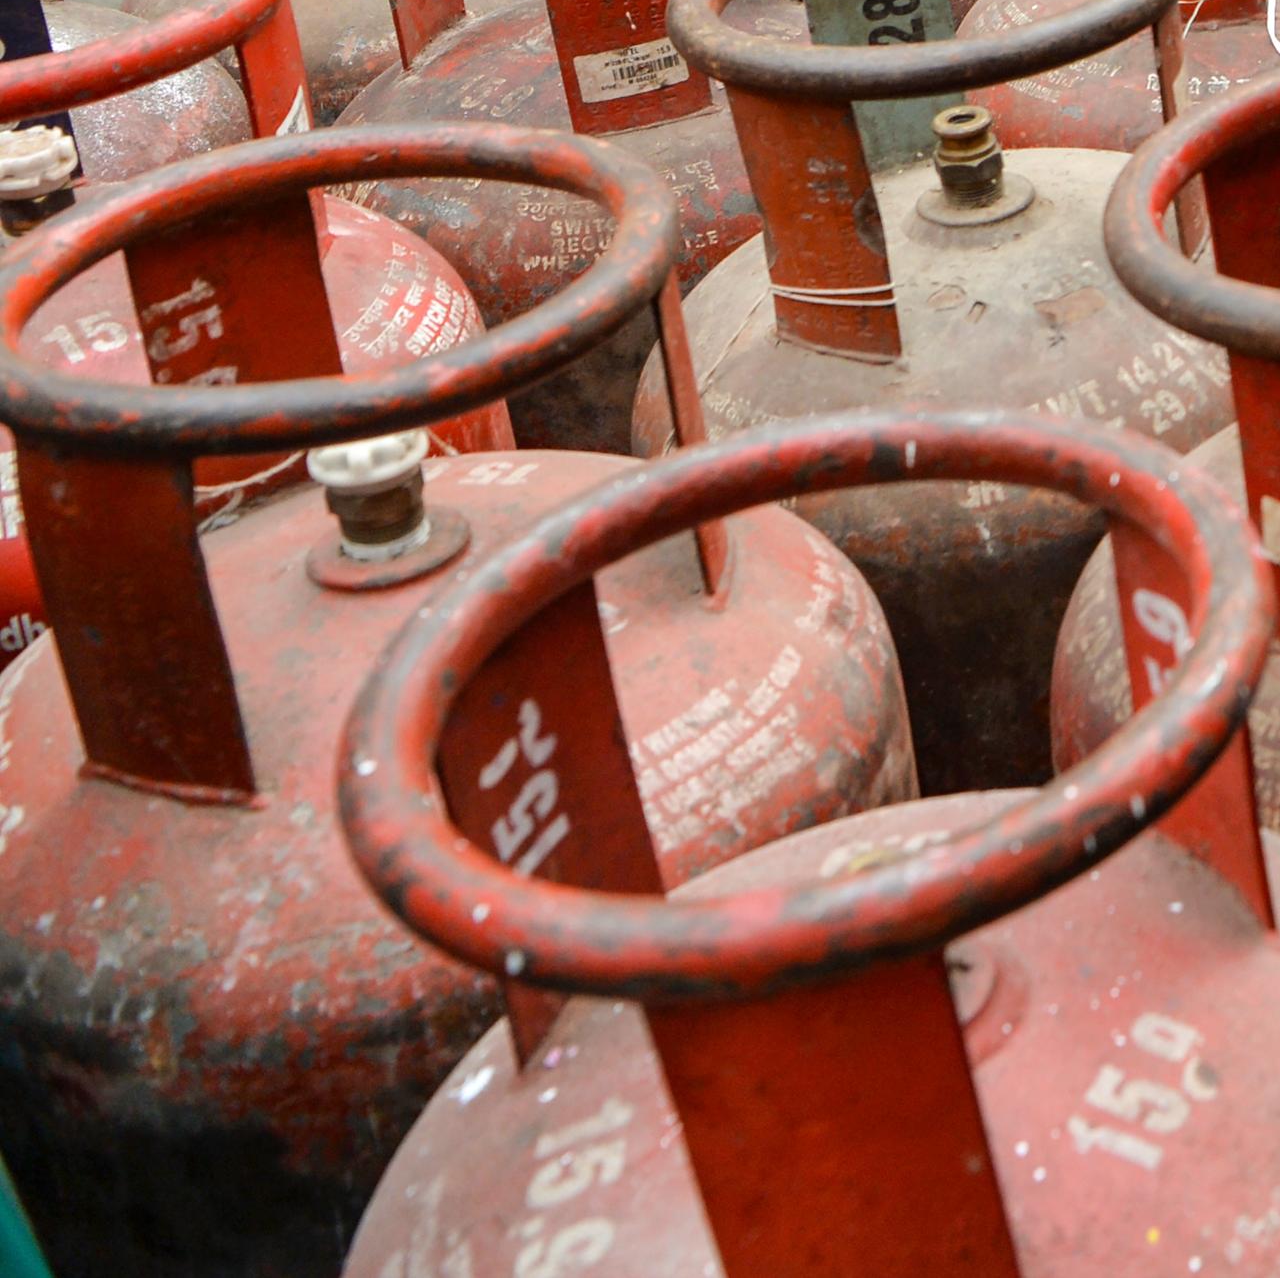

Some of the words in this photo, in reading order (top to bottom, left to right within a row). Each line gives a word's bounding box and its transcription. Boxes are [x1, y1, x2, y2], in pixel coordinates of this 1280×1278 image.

[41, 310, 143, 365] 15.
[404, 299, 448, 357] SWITCH
[1117, 341, 1185, 395] 14.2
